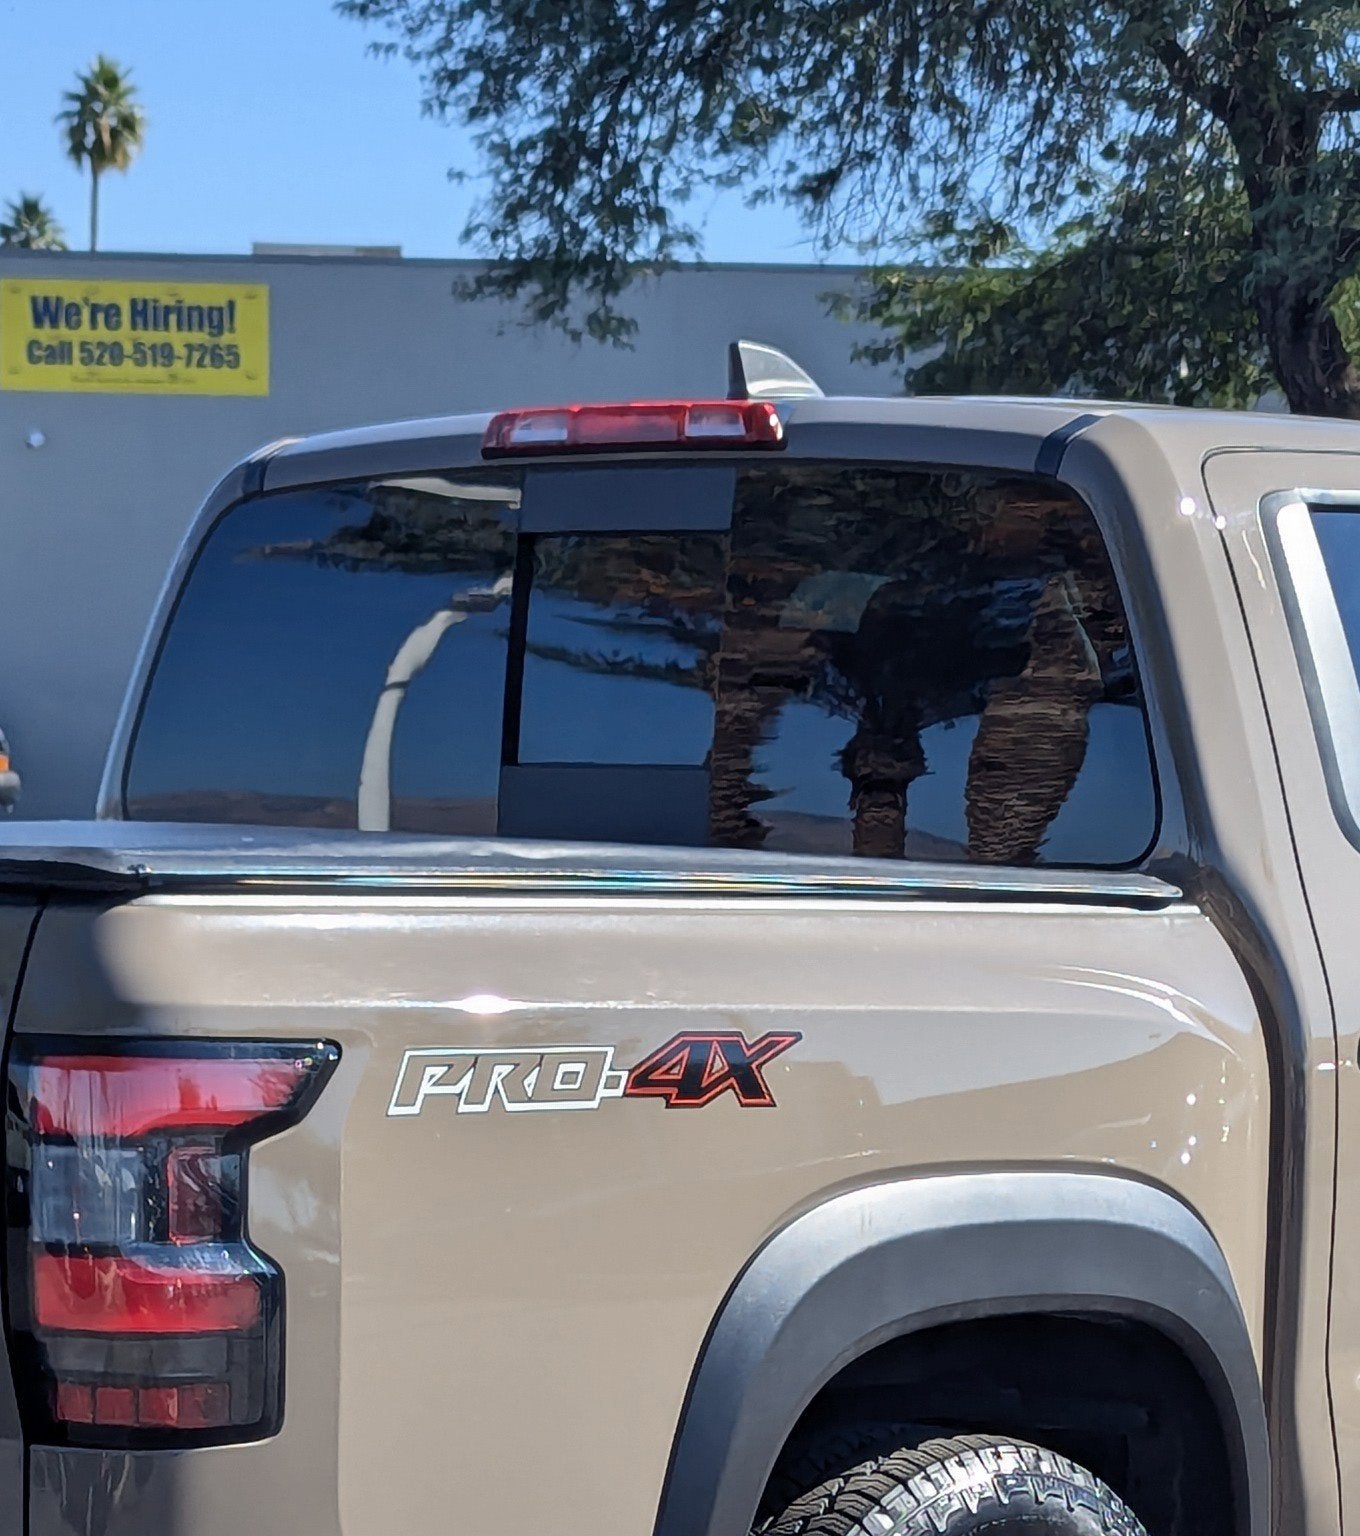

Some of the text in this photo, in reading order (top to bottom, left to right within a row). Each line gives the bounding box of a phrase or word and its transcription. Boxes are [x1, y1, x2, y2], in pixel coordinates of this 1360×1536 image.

[30, 295, 236, 338] We're Hiring!
[27, 339, 240, 369] Call 520-519-7265
[387, 1031, 802, 1117] PRO-4X
